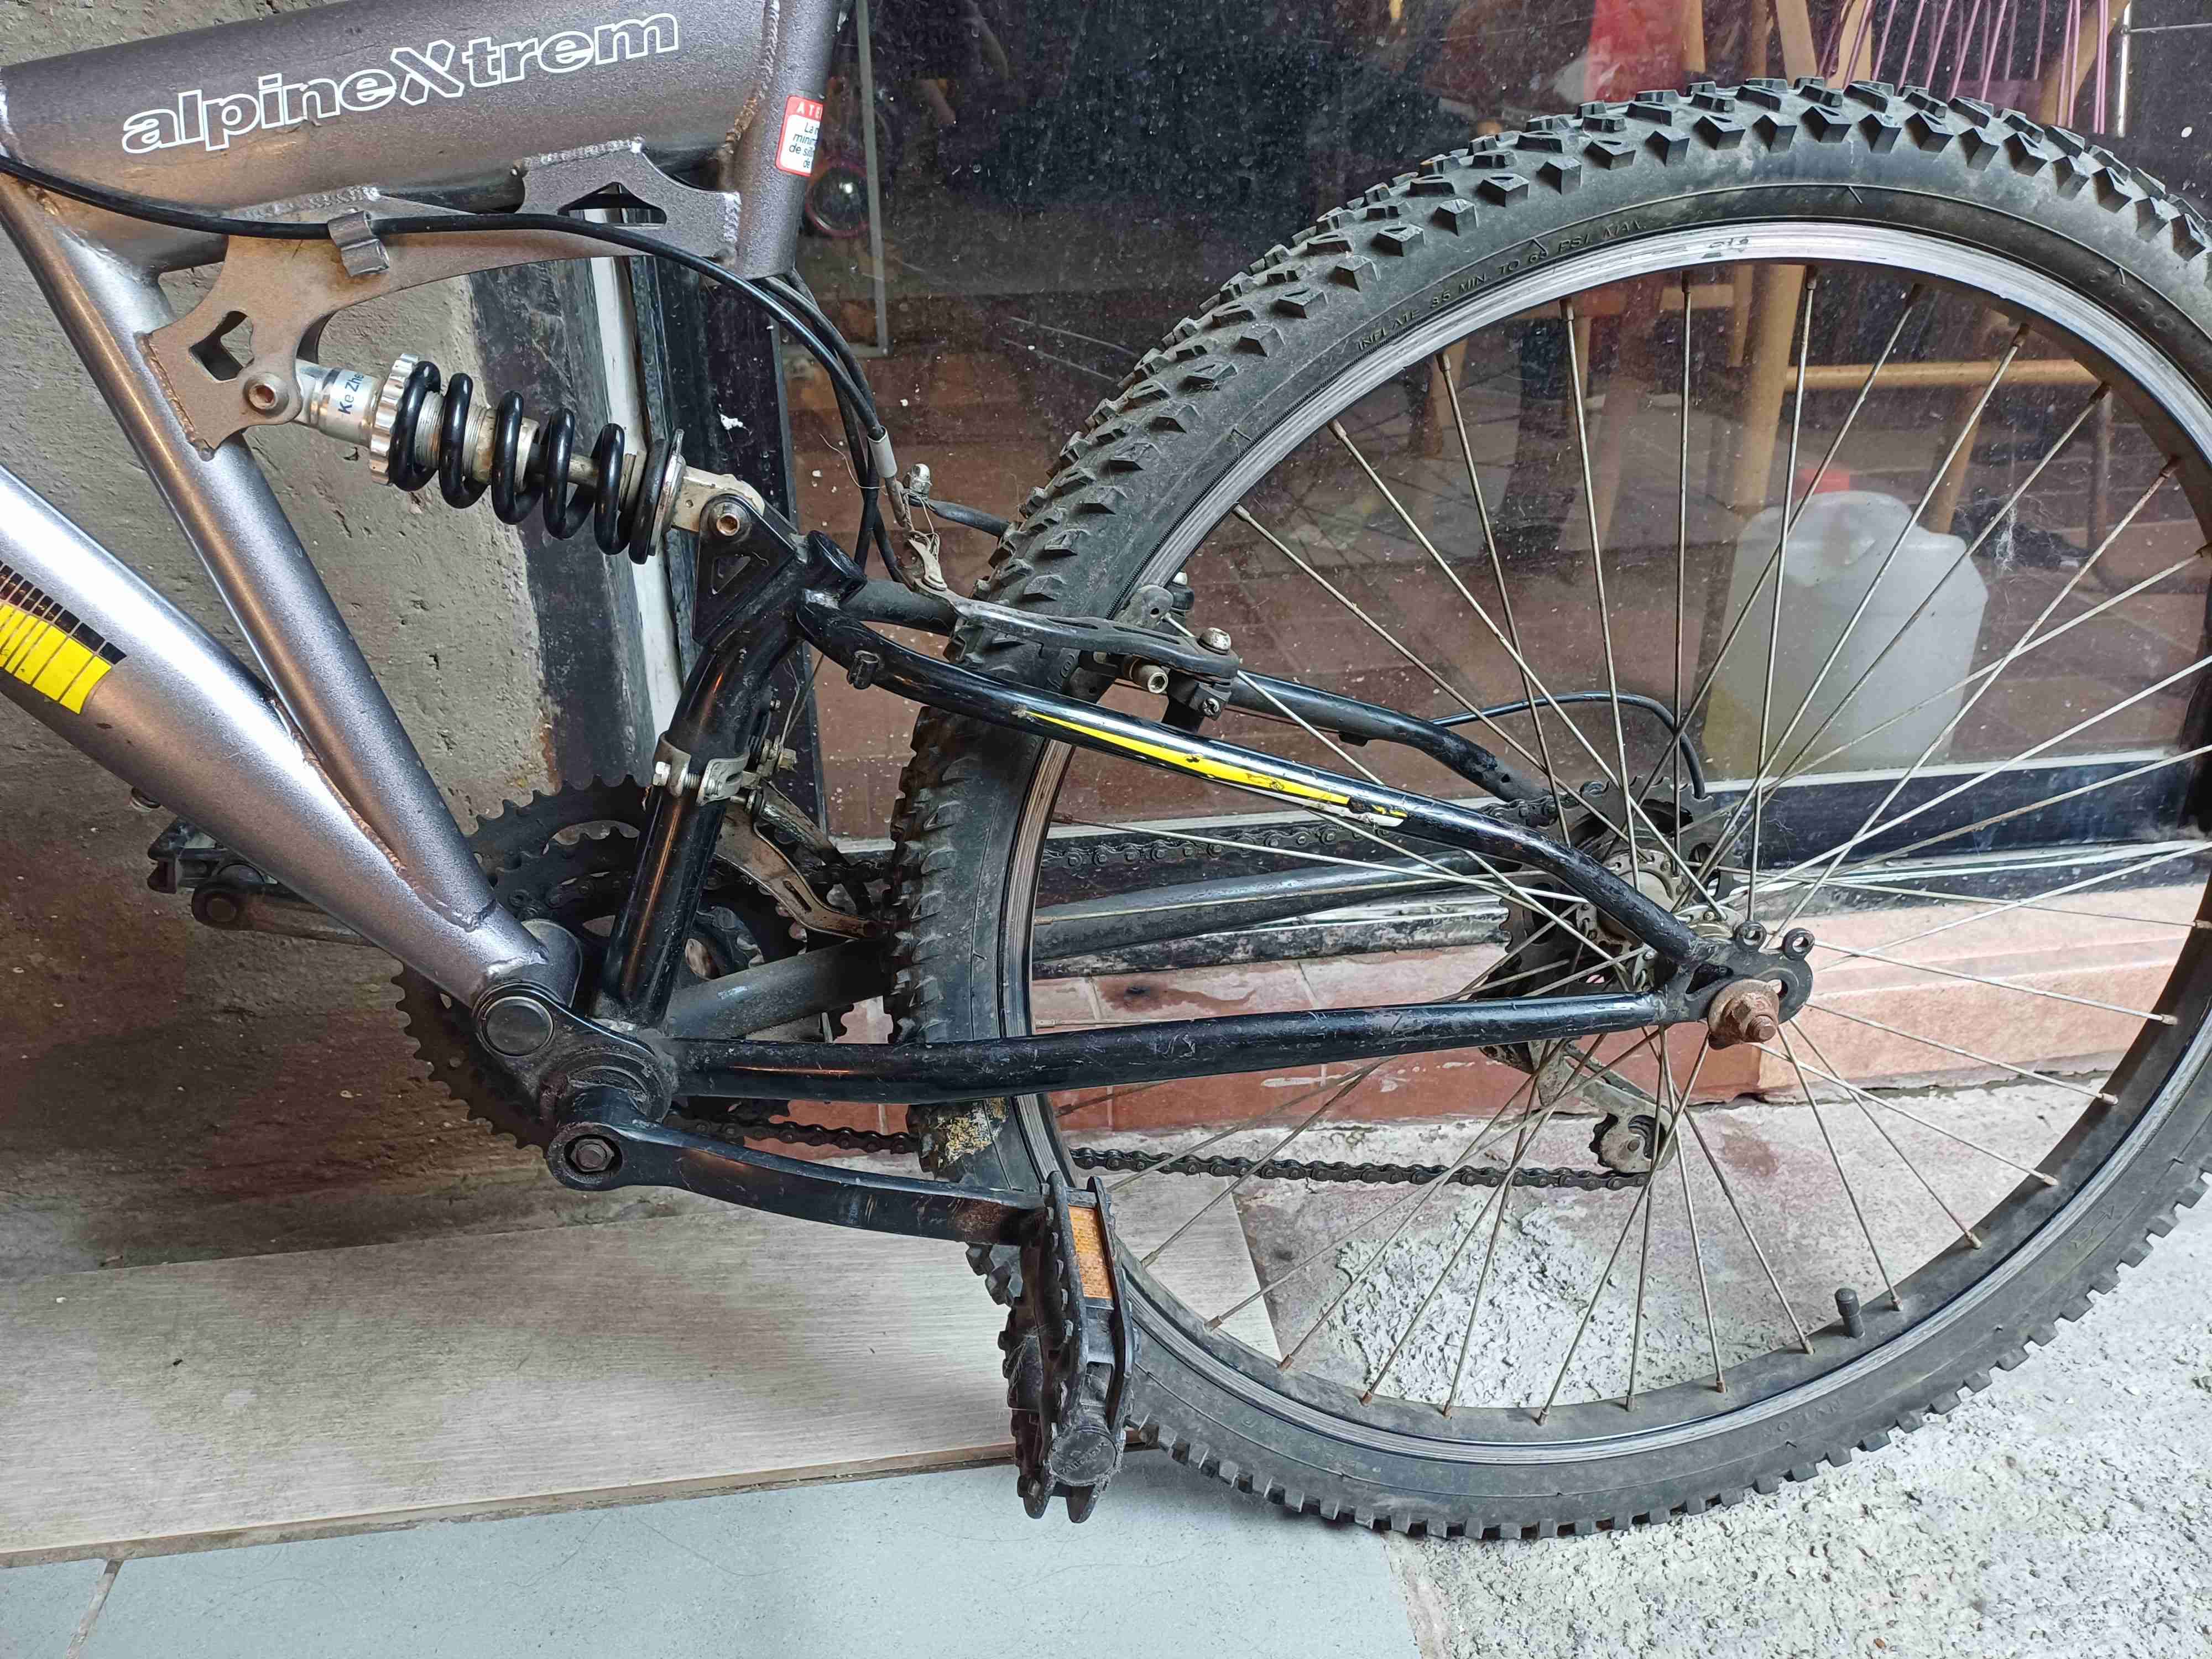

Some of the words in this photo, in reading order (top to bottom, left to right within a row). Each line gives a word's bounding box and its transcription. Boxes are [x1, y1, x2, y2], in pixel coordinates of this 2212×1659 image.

[121, 13, 679, 154] alpineXtrem
[796, 101, 822, 119] ATE
[789, 143, 801, 154] de
[338, 394, 354, 414] Ke
